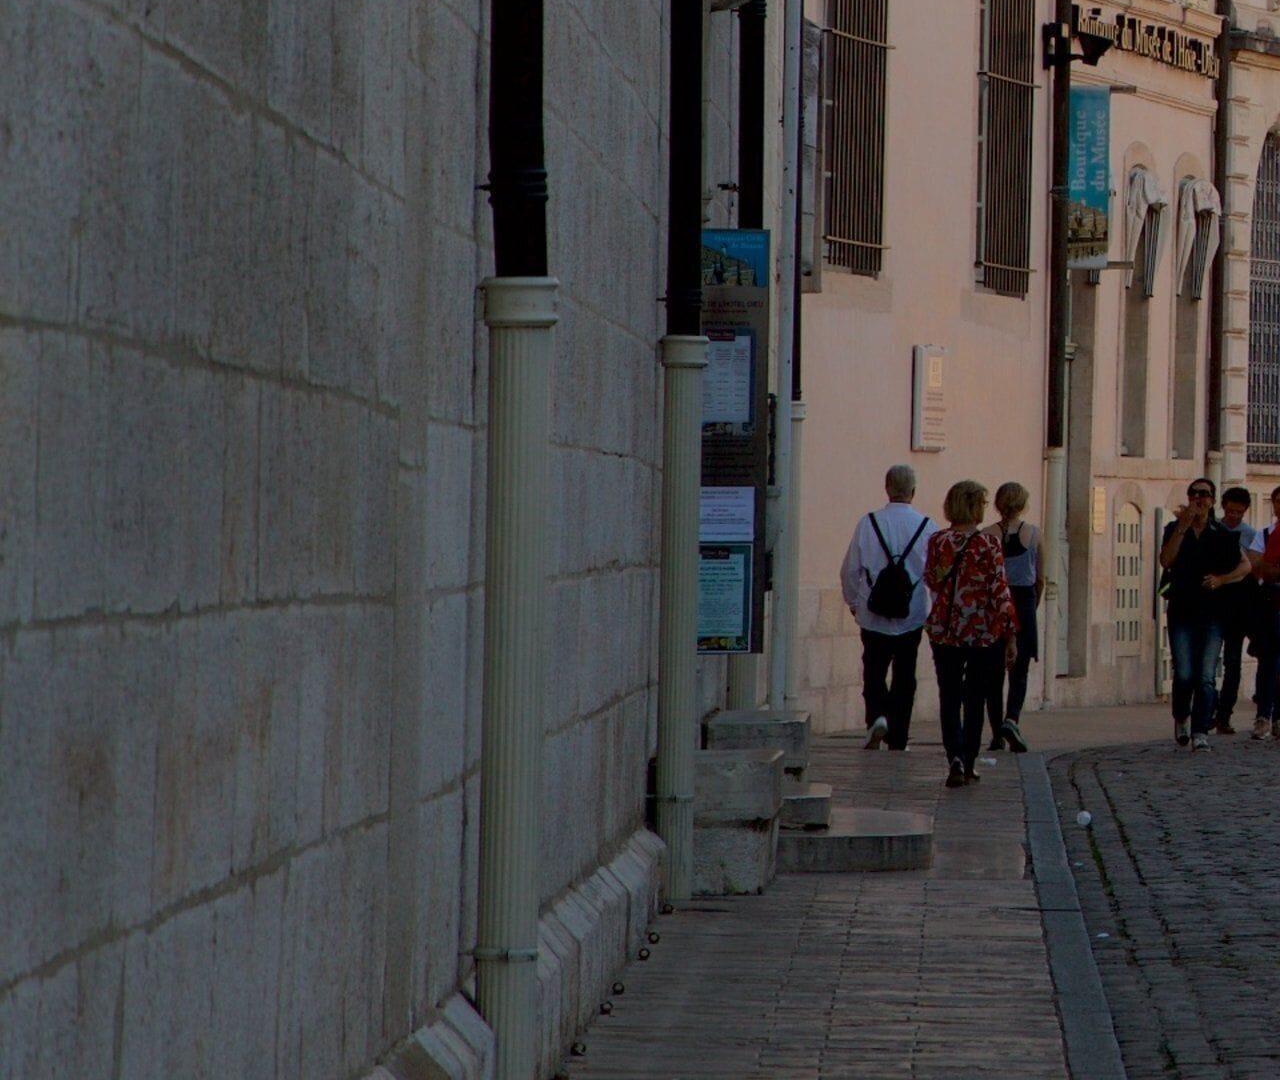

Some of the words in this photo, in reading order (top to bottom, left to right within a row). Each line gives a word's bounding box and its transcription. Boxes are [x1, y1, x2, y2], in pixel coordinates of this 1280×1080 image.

[1070, 110, 1091, 191] Boutique
[1090, 110, 1106, 164] Musée
[1090, 169, 1105, 191] du
